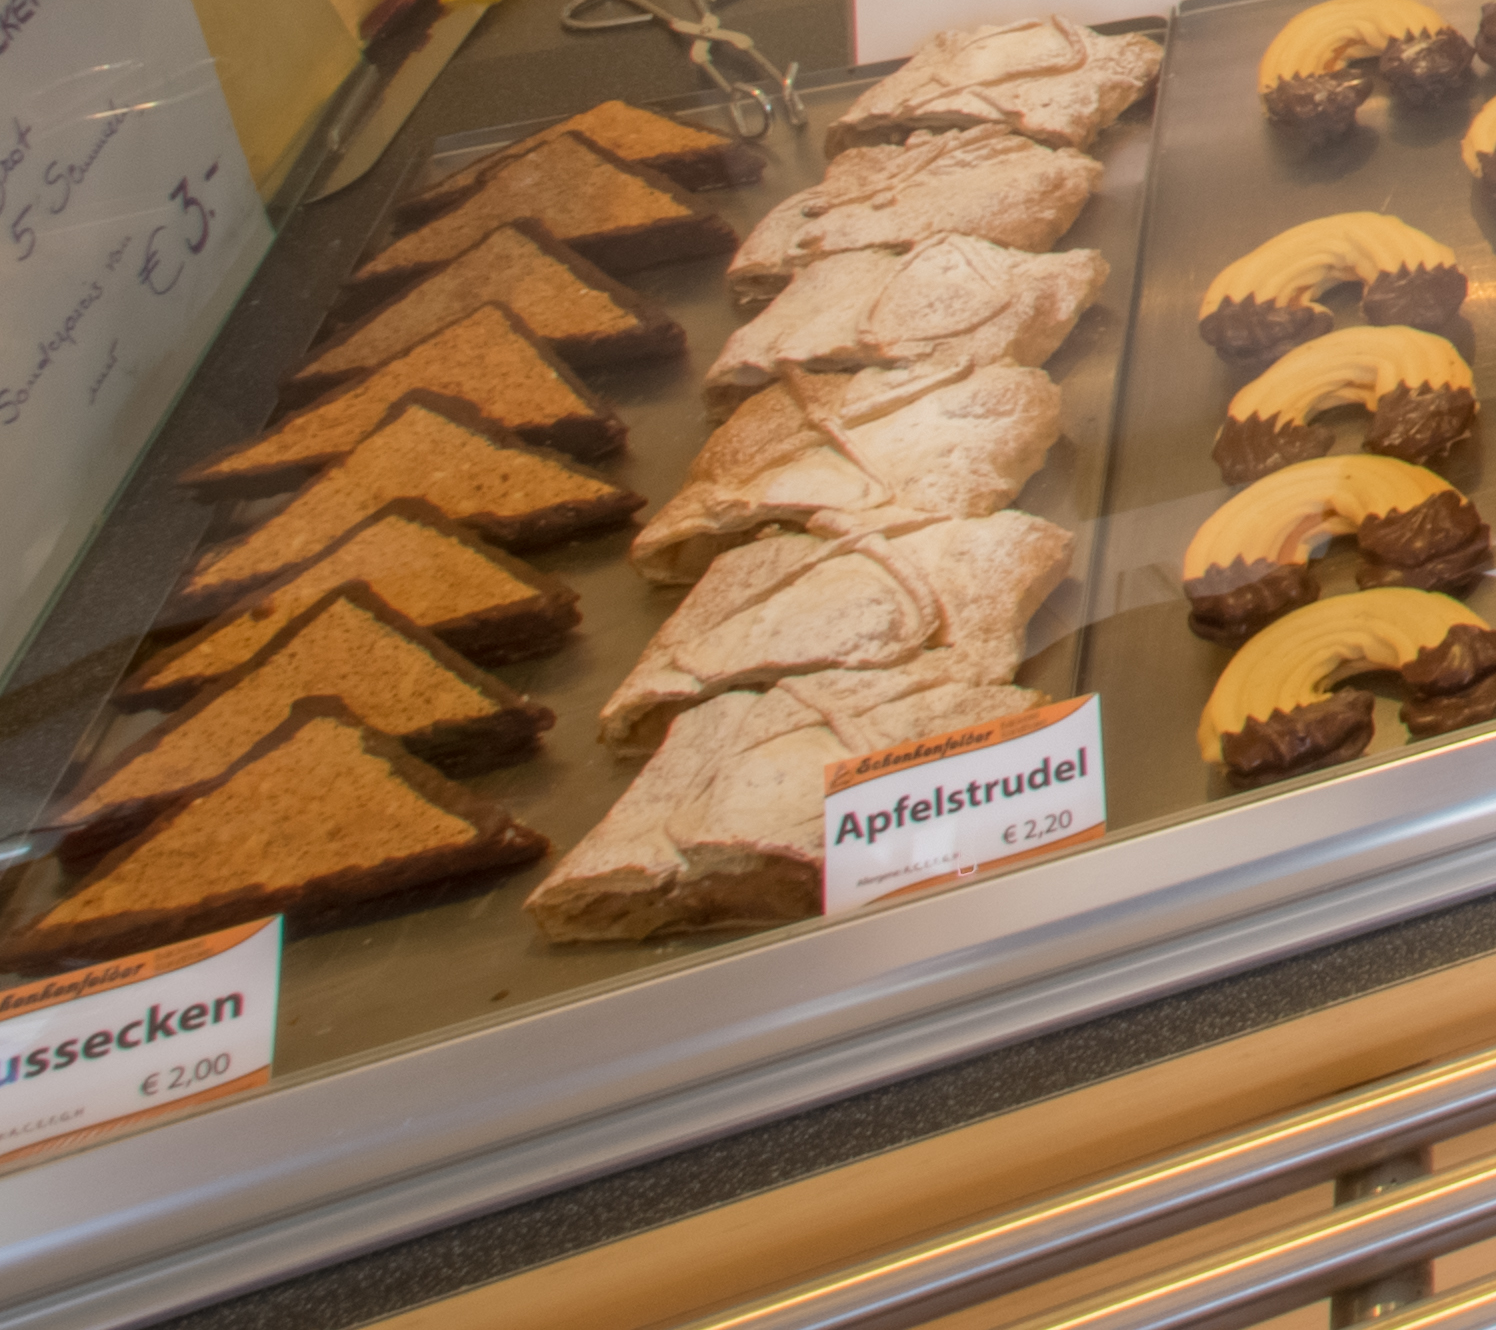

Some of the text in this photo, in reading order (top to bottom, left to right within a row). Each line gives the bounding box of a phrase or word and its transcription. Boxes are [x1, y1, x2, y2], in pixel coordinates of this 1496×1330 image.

[856, 729, 995, 776] Schenkenfelder
[834, 746, 1088, 845] Apfelstrudel
[1003, 809, 1073, 844] € 2,20
[139, 1052, 231, 1096] € 2,00
